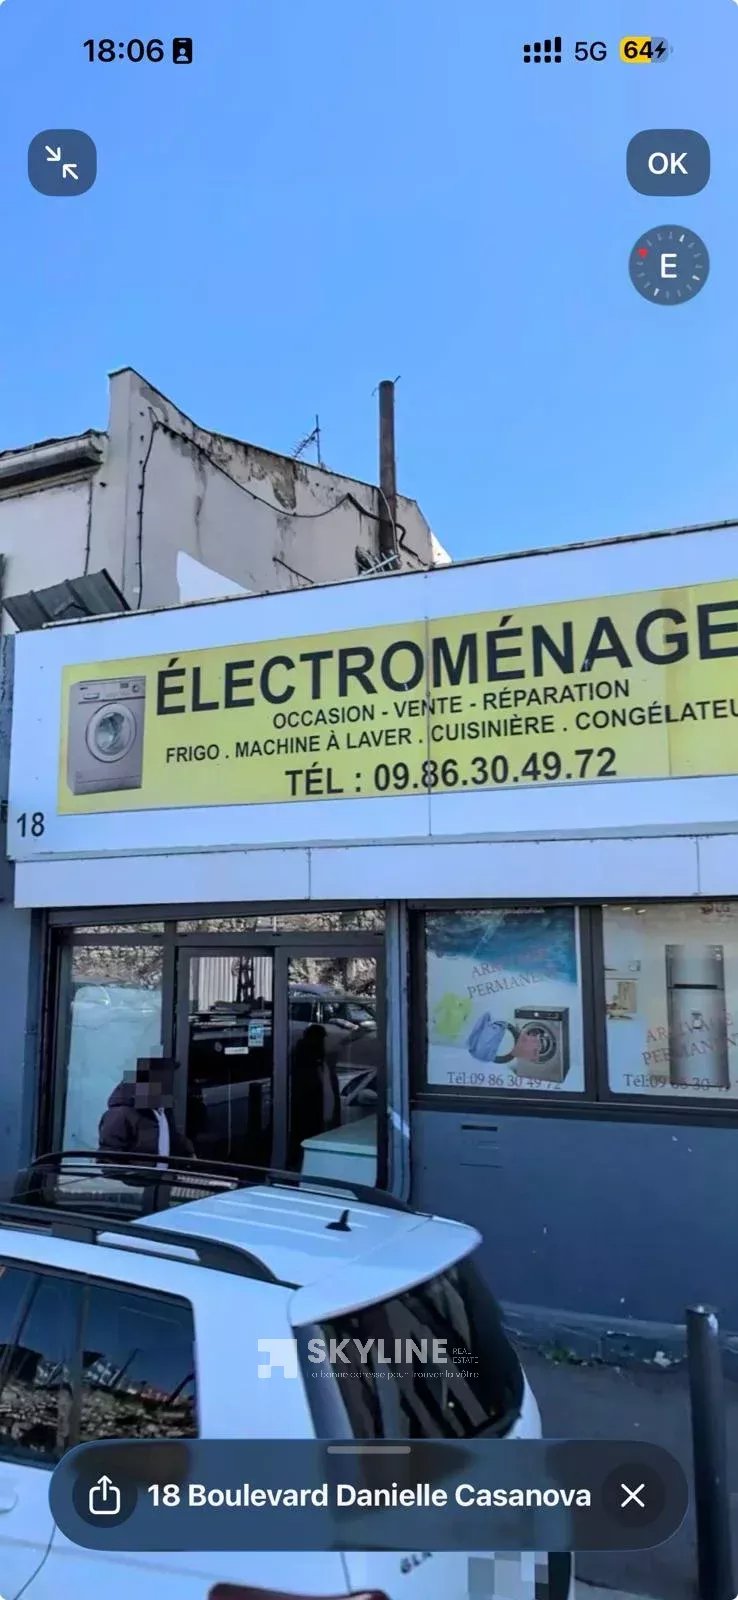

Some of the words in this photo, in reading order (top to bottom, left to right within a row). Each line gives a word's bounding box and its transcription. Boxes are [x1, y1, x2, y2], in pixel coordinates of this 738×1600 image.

[83, 38, 165, 63] 18:06
[574, 41, 608, 62] 5G
[623, 40, 653, 59] 64
[648, 151, 689, 175] OK
[660, 253, 678, 279] E
[156, 600, 738, 717] ÉLECTROMÉNAGE
[272, 703, 375, 730] OCCASION
[393, 695, 463, 719] VENTE
[482, 678, 631, 711] RÉPARATION
[165, 743, 221, 764] FRIGO
[235, 735, 322, 759] MACHINE
[326, 732, 341, 751] À
[346, 727, 413, 749] LAVER
[431, 713, 556, 743] CUISINIÈRE
[284, 762, 344, 797] TÉL
[374, 746, 618, 792] 09.86.30.49.72
[16, 811, 46, 838] 18
[488, 1073, 505, 1087] 86
